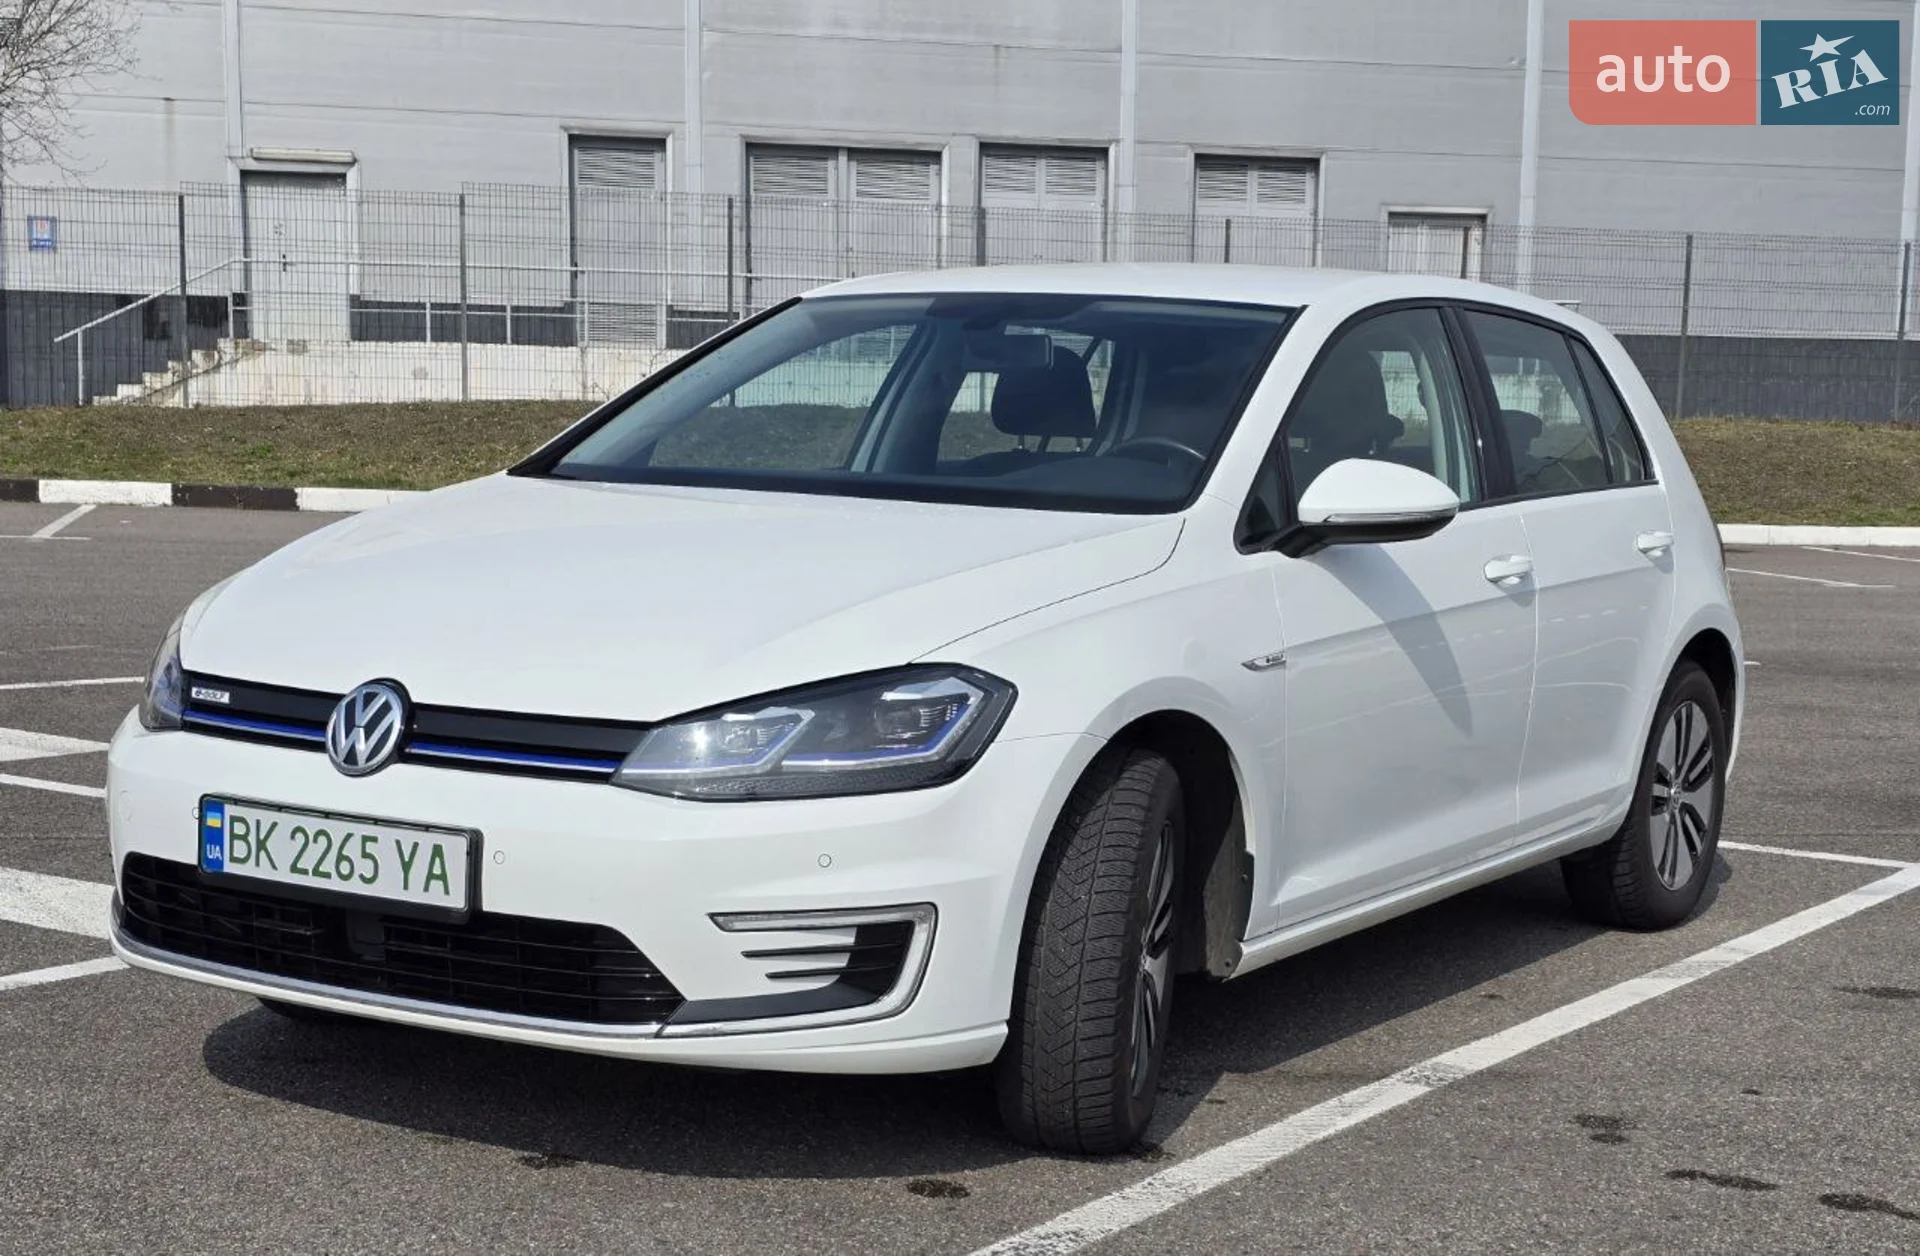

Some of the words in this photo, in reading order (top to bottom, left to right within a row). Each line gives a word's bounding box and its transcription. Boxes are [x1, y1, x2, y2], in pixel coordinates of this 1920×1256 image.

[206, 844, 222, 860] UA
[228, 815, 278, 871] BK
[289, 825, 379, 885] 2265
[395, 839, 450, 896] YA
